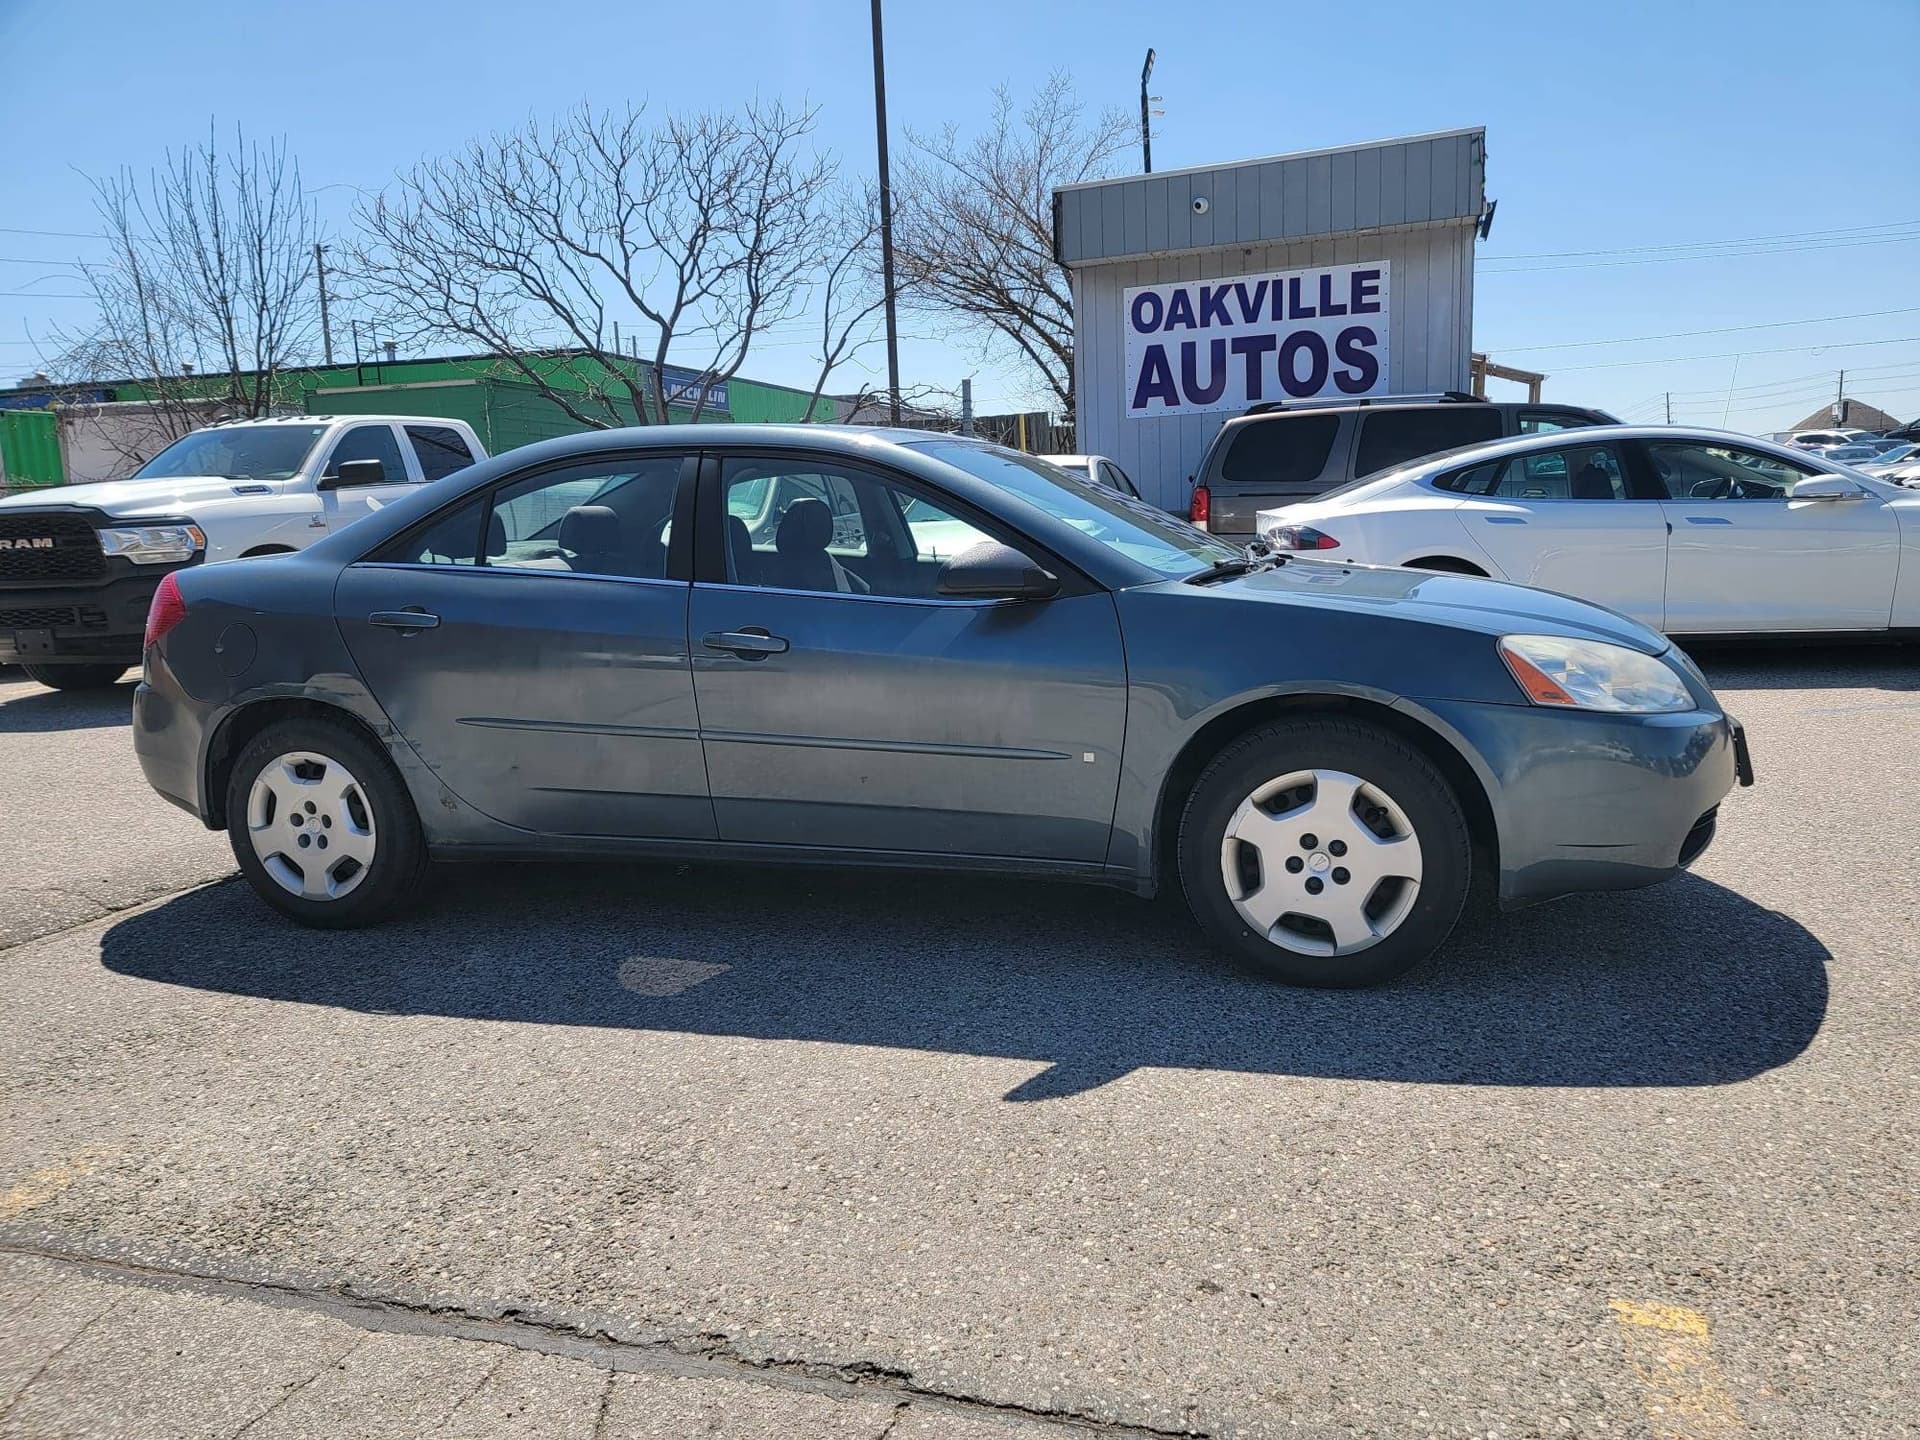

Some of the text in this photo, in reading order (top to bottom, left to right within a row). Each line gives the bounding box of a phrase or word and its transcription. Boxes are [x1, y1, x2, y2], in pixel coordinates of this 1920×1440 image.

[1131, 269, 1381, 334] OAKVILLE
[1132, 326, 1379, 409] AUTOS
[670, 383, 726, 403] MICHLIN
[0, 537, 53, 550] RAM
